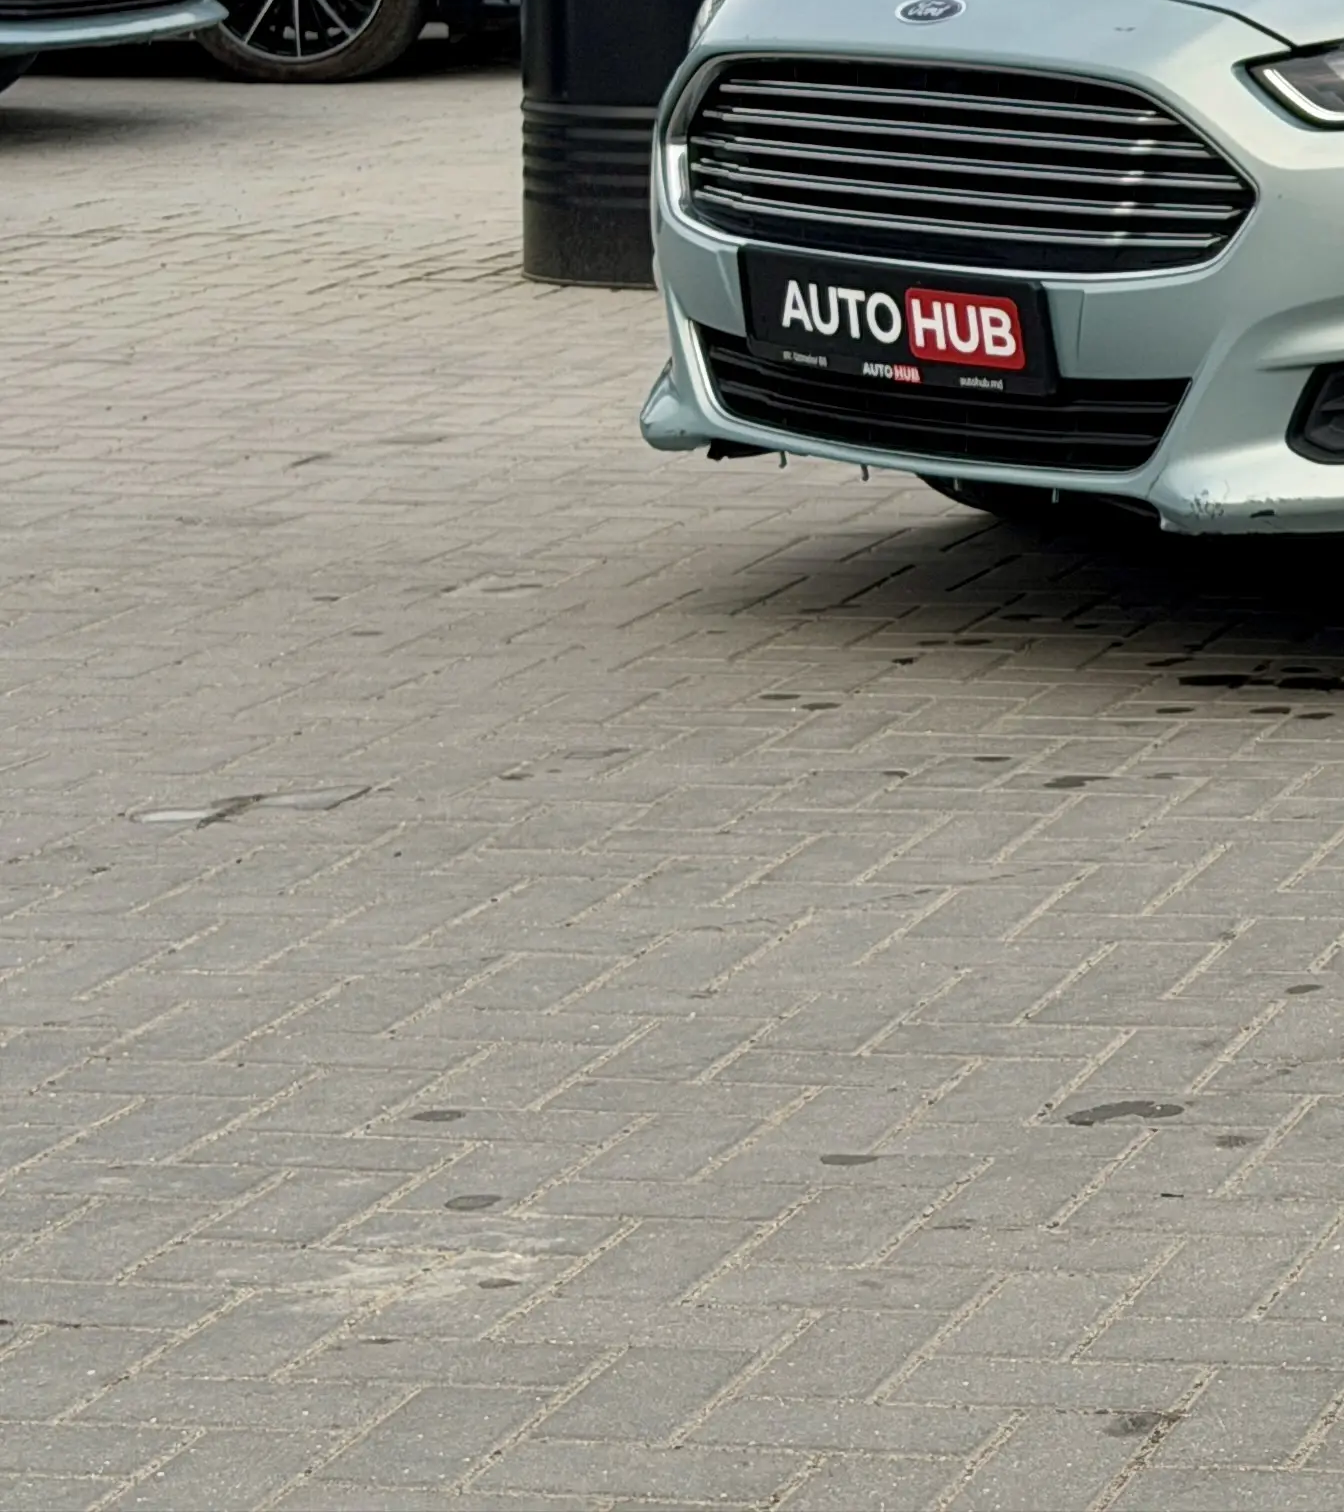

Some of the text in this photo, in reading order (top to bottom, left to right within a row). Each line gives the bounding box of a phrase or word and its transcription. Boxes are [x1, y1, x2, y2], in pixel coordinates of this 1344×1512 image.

[781, 279, 1018, 357] AUTO HUB
[862, 362, 921, 384] AUTO HUB
